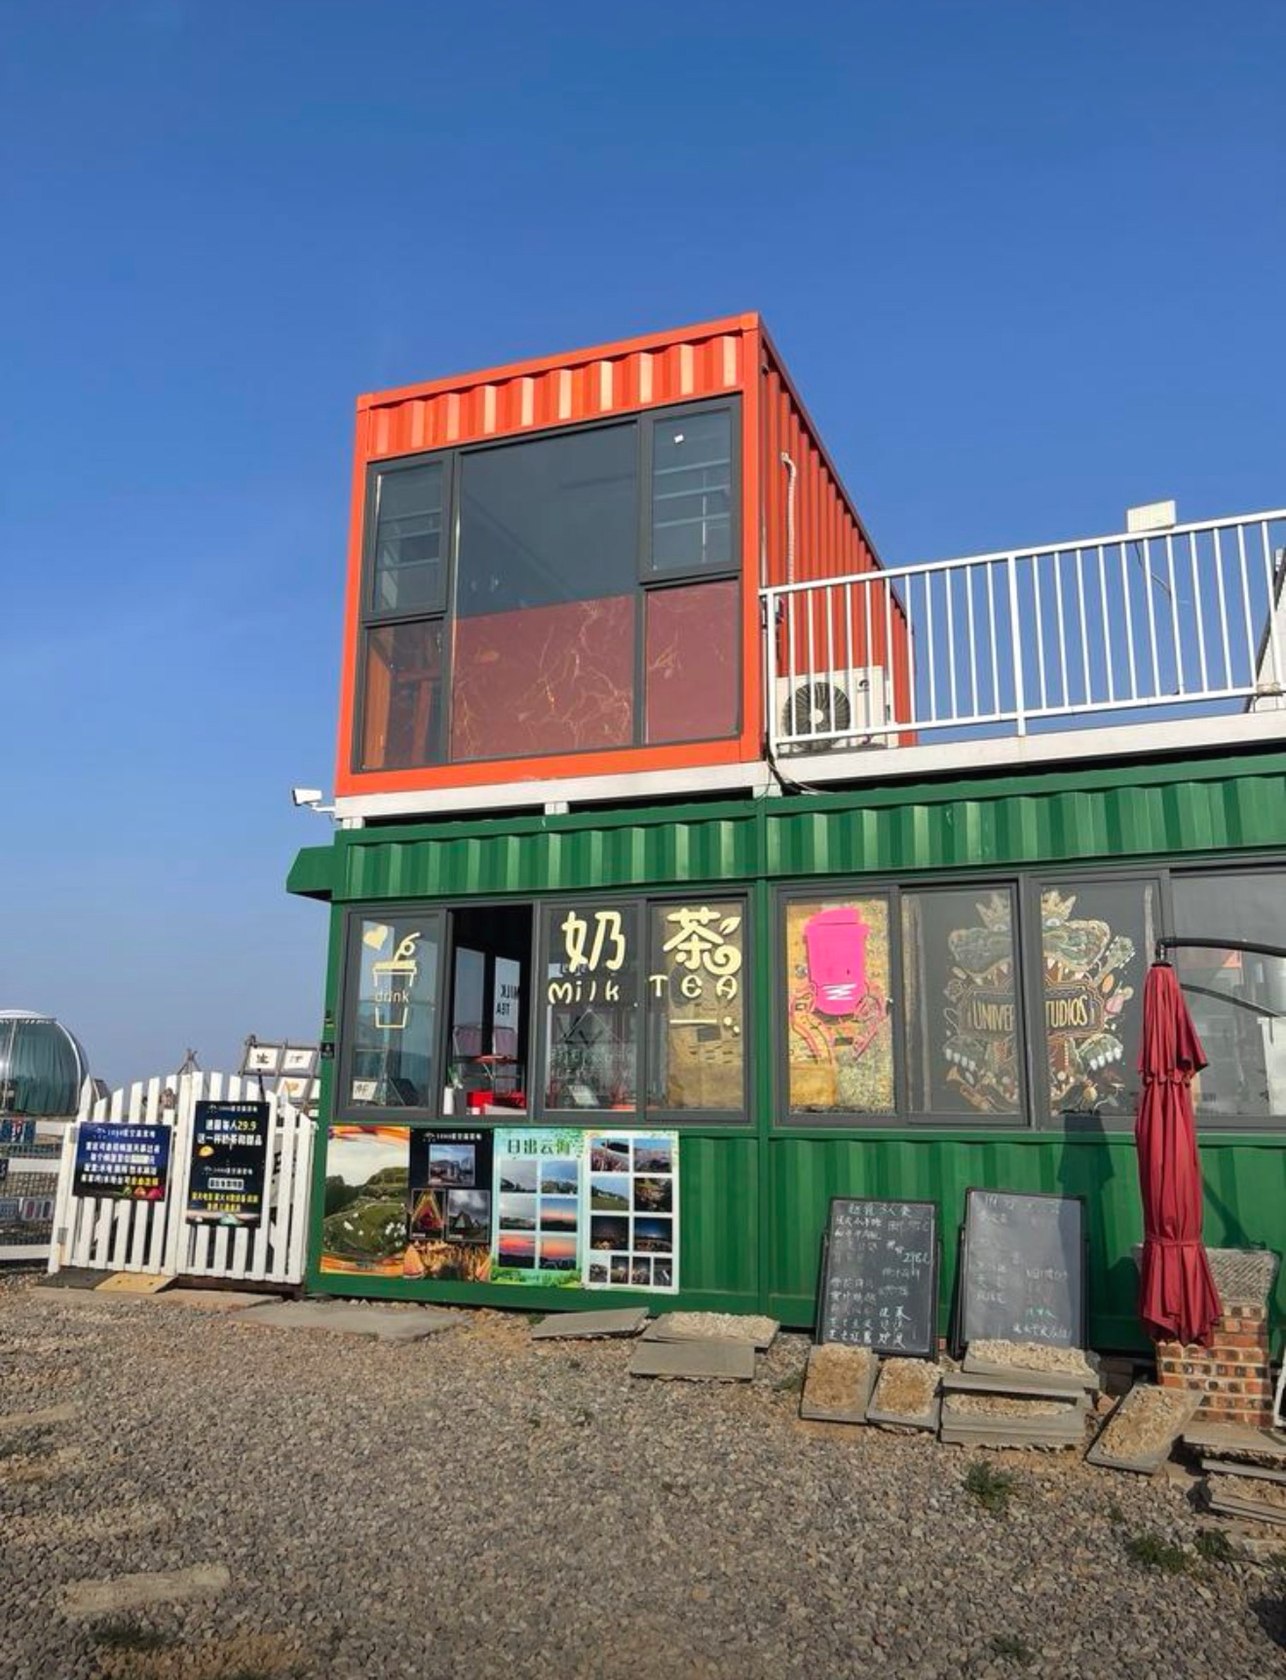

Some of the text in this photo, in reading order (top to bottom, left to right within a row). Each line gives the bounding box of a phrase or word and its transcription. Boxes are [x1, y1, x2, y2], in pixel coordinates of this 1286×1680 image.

[561, 907, 742, 975] 奶茶
[374, 989, 411, 1003] drink
[548, 974, 738, 1004] Milk TEA
[508, 1137, 570, 1156] 日出云海
